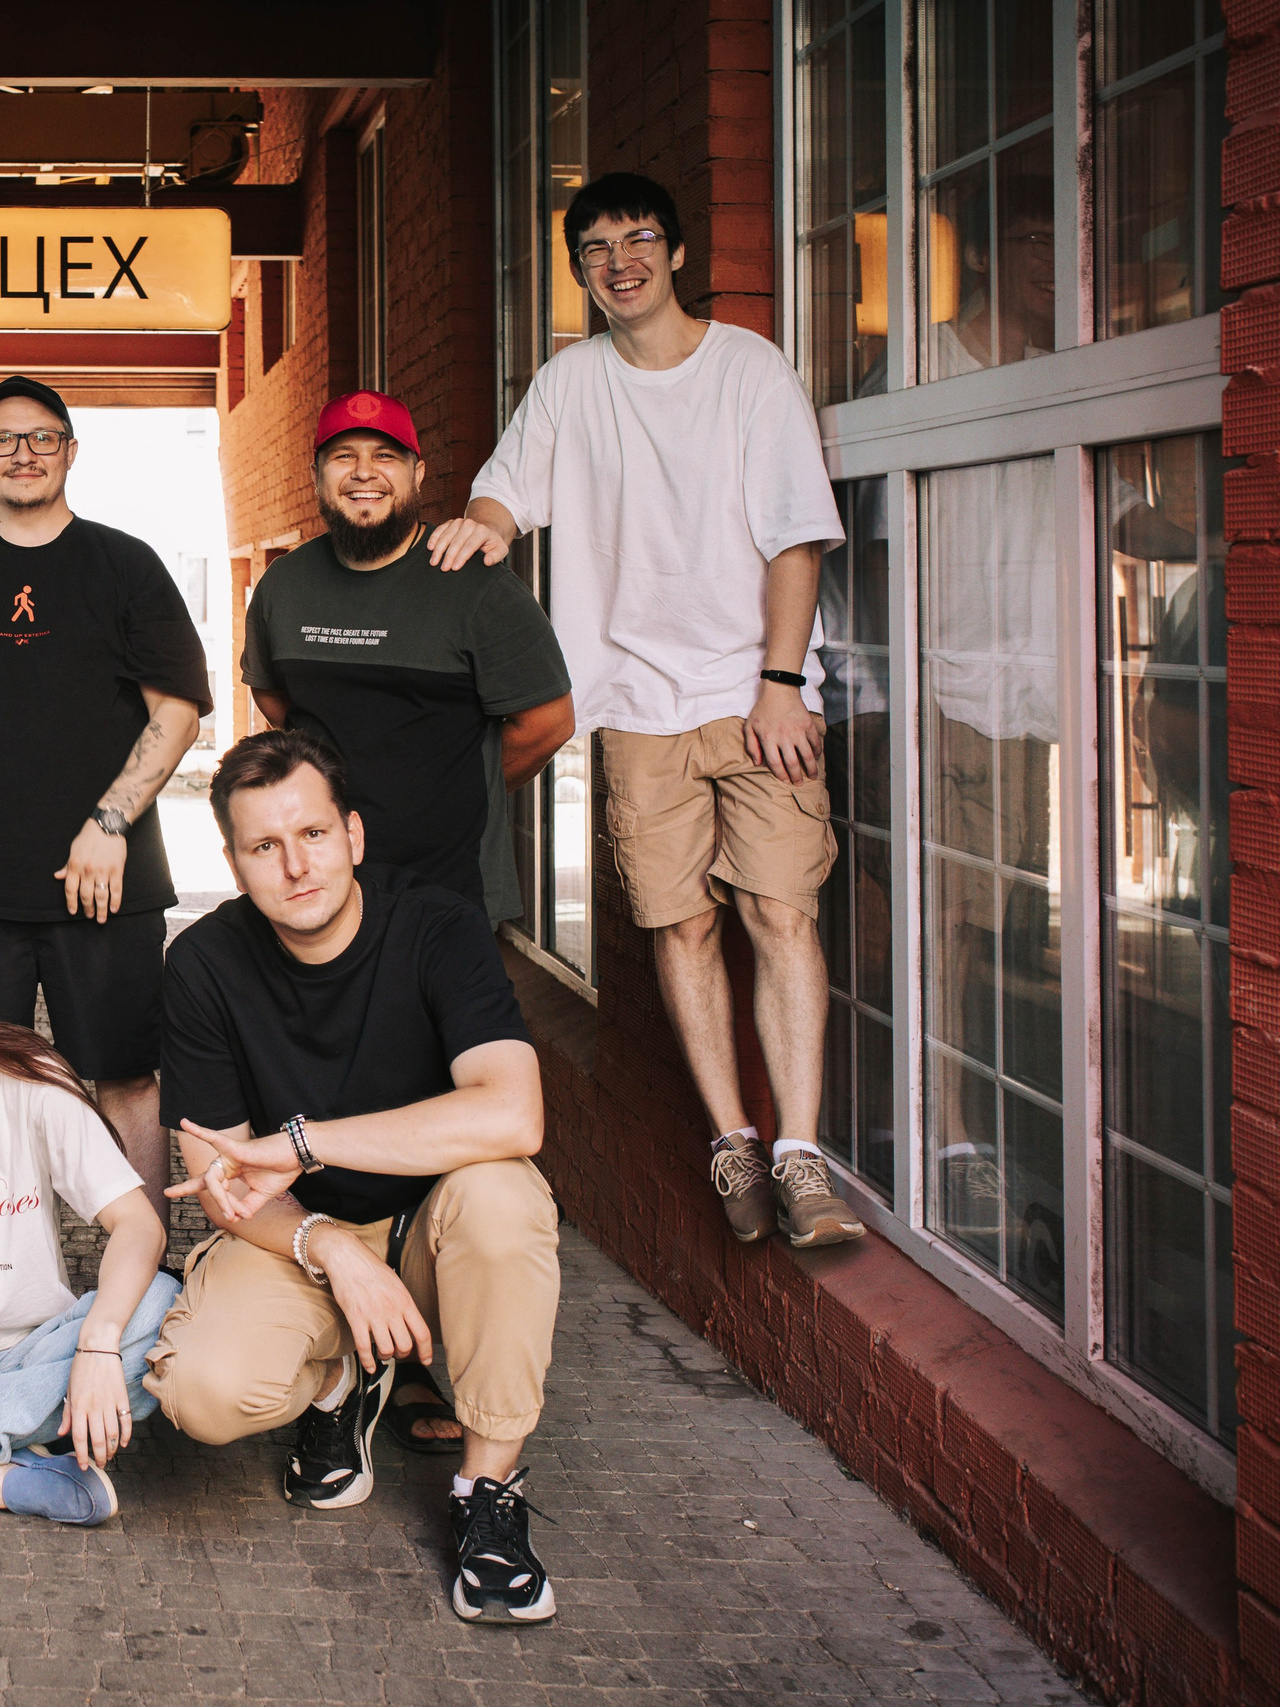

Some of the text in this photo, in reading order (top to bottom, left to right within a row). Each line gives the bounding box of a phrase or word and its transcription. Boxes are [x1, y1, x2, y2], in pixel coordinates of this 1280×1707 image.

[0, 236, 149, 314] ЦЕХ
[301, 626, 321, 634] RESPECT
[321, 627, 330, 635] THE
[343, 629, 360, 637] CREATE
[361, 629, 370, 637] THE
[370, 630, 389, 638] FUTURE
[305, 634, 380, 646] LOST TIME IS NEVER FOUND AGAIN
